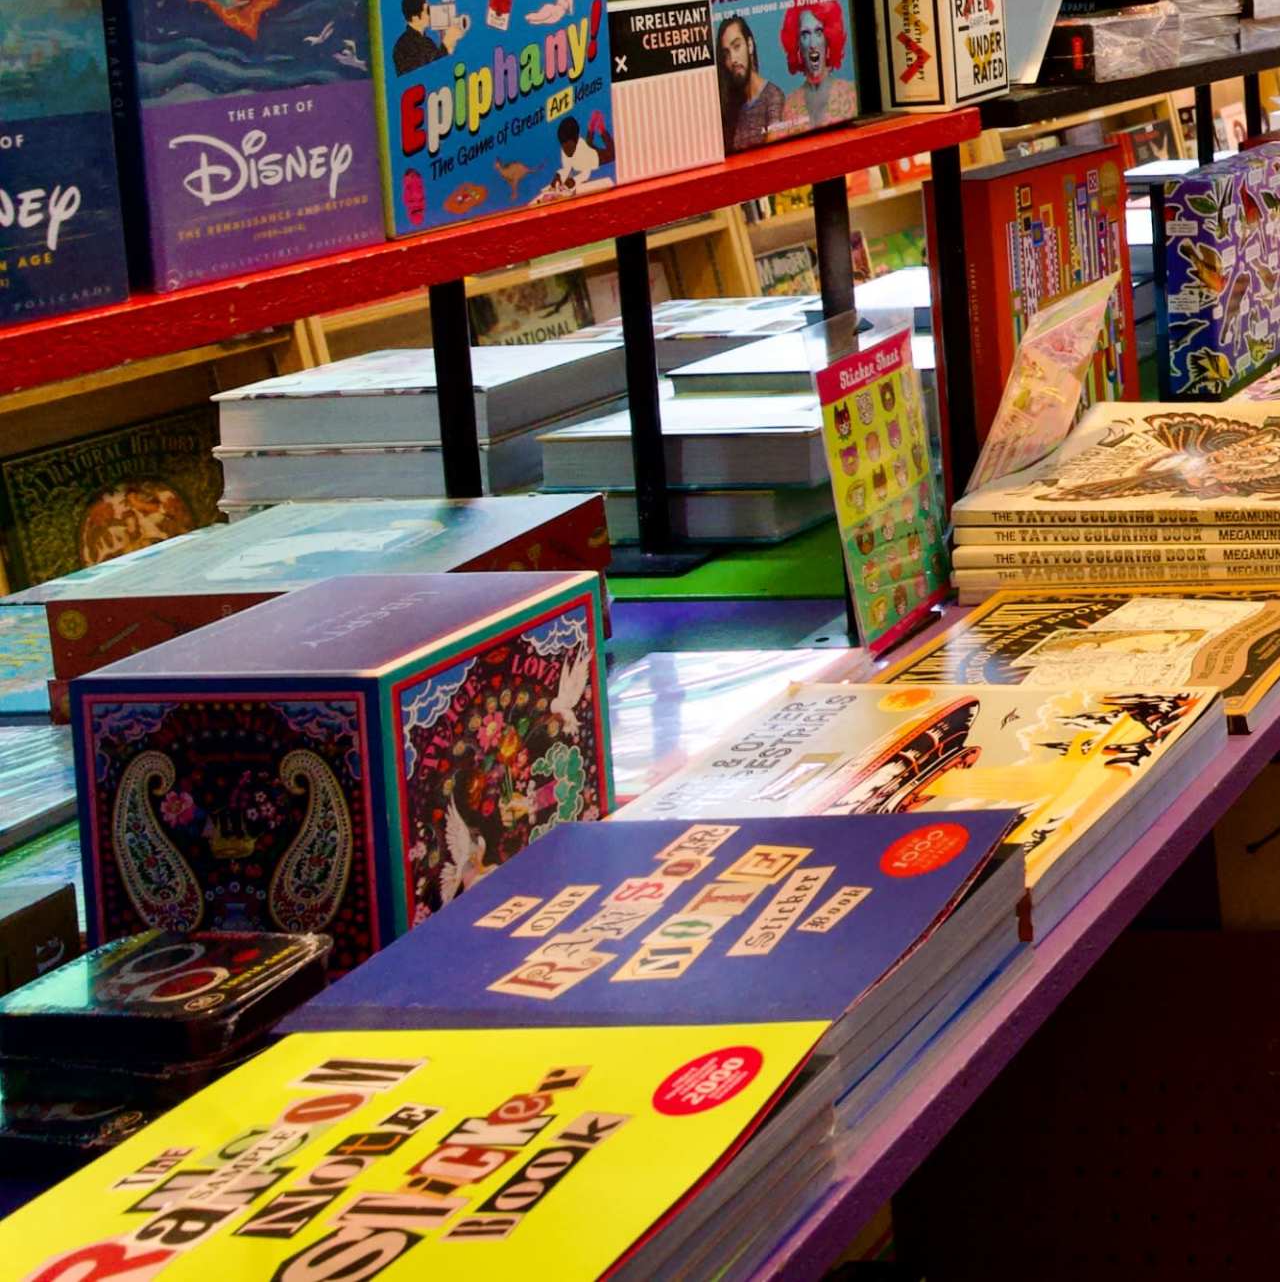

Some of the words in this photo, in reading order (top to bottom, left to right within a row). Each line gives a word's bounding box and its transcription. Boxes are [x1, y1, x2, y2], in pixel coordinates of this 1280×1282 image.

[630, 6, 708, 33] IRRELEVANT
[642, 24, 710, 51] CELEBRITY
[967, 31, 1003, 60] UNDER
[672, 44, 711, 67] TRIVIA
[973, 57, 1005, 86] RATED
[228, 109, 257, 124] THE
[262, 103, 290, 120] ART
[294, 99, 316, 114] OF
[430, 156, 455, 181] The
[457, 137, 495, 166] Game
[497, 123, 510, 146] of
[510, 107, 546, 137] Great
[549, 92, 571, 118] Art
[573, 76, 604, 105] Ideas
[17, 252, 54, 269] AGE
[838, 362, 872, 392] Sticker
[874, 347, 902, 380] Sheet
[992, 511, 1013, 524] THE
[1015, 510, 1079, 525] TATTOO
[1080, 509, 1156, 525] COLORING
[1158, 509, 1200, 525] BOOK
[994, 529, 1017, 542] THE
[1018, 528, 1082, 543] TATTOO
[1083, 527, 1159, 542] COLORING
[1161, 527, 1203, 542] BOOK
[994, 552, 1016, 565] THE
[1017, 550, 1083, 565] TATTOO
[1084, 549, 1162, 565] COLORING
[1165, 548, 1207, 564] BOOK
[1043, 602, 1109, 625] BOOK
[892, 829, 945, 869] 1000
[744, 873, 821, 950] Sticker
[806, 889, 860, 931] Book
[681, 1056, 745, 1106] 2000
[188, 1127, 298, 1202] SAMPLE
